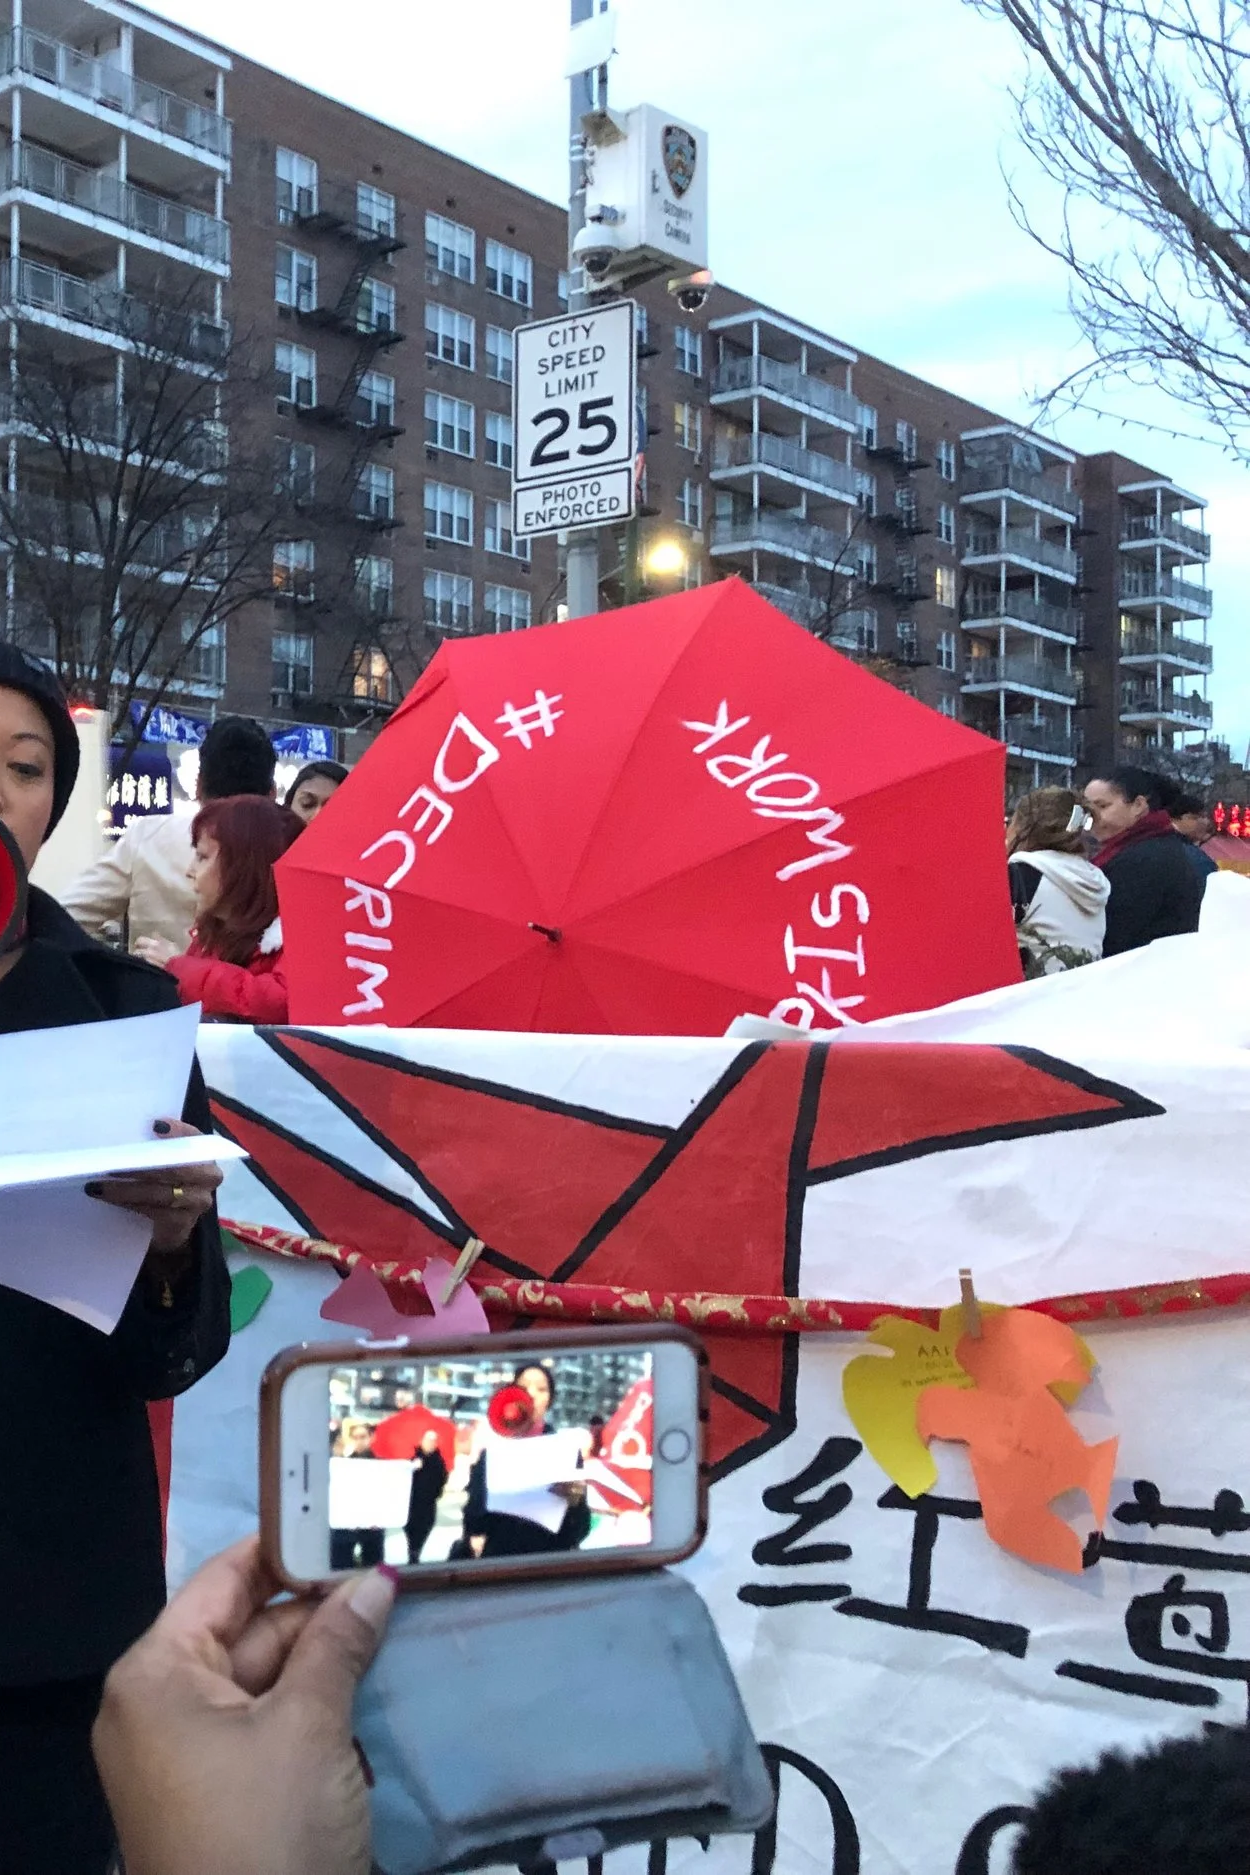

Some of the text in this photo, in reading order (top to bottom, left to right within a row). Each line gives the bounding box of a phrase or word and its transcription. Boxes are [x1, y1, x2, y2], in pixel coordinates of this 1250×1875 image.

[548, 321, 595, 348] CITY
[537, 346, 606, 375] SPEED
[545, 371, 598, 398] LIMIT
[530, 396, 617, 467] 25
[542, 481, 601, 505] PHOTO
[524, 497, 620, 527] ENFORCED
[680, 698, 855, 881] WORK
[344, 689, 564, 1027] #DECRIM
